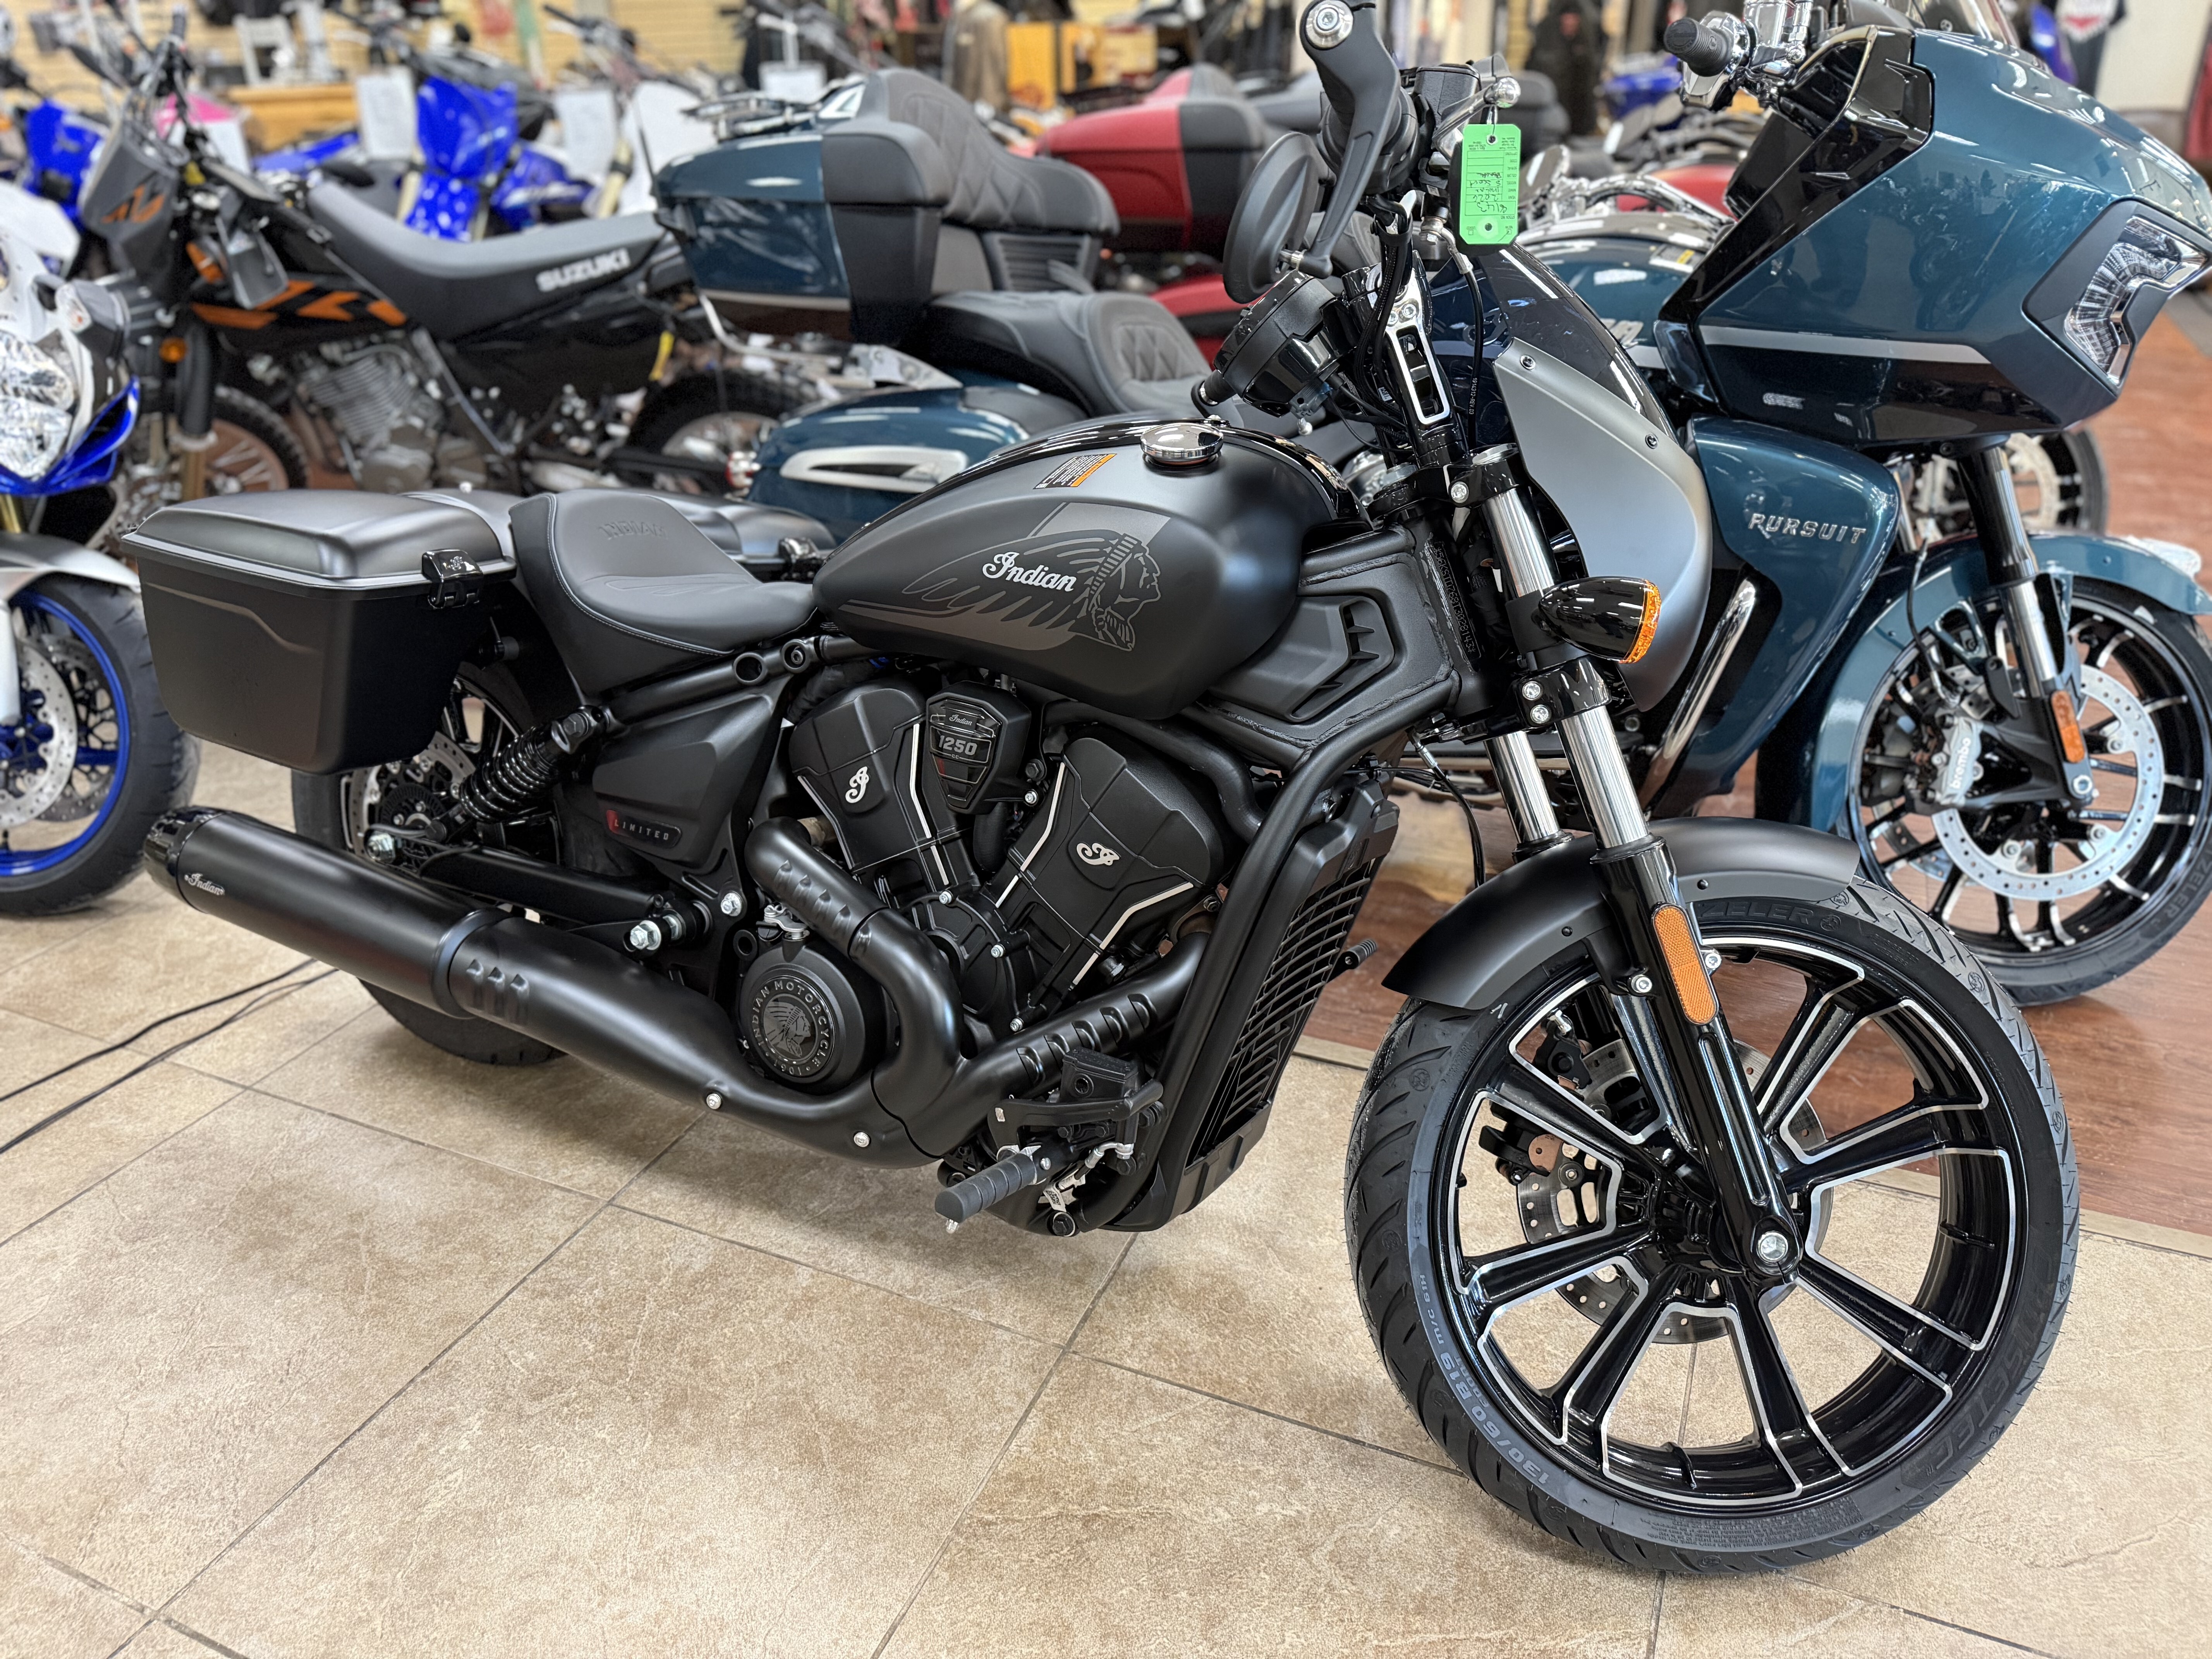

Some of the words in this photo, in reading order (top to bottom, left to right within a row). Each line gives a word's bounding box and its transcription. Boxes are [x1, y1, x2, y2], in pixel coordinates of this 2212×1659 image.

[1477, 202, 1507, 213] 8143
[536, 248, 630, 291] SUZUKI
[1748, 513, 1867, 544] PURSUIT
[982, 551, 1077, 592] Indian
[949, 714, 973, 726] Indian
[939, 735, 978, 756] 1250
[1949, 737, 1972, 789] brembo
[614, 819, 669, 840] LIMITED
[188, 873, 220, 896] Indian
[2166, 853, 2212, 918] ZELER
[1698, 902, 1814, 925] ZELER
[752, 986, 770, 1046] INDIAN
[775, 980, 830, 1067] MOTORCYCLE
[773, 1059, 802, 1075] 1901
[1419, 1274, 1430, 1302] 61H
[1440, 1352, 1472, 1400] B19
[1453, 1355, 1489, 1408] FRONT
[1472, 1405, 1549, 1484] 130/60
